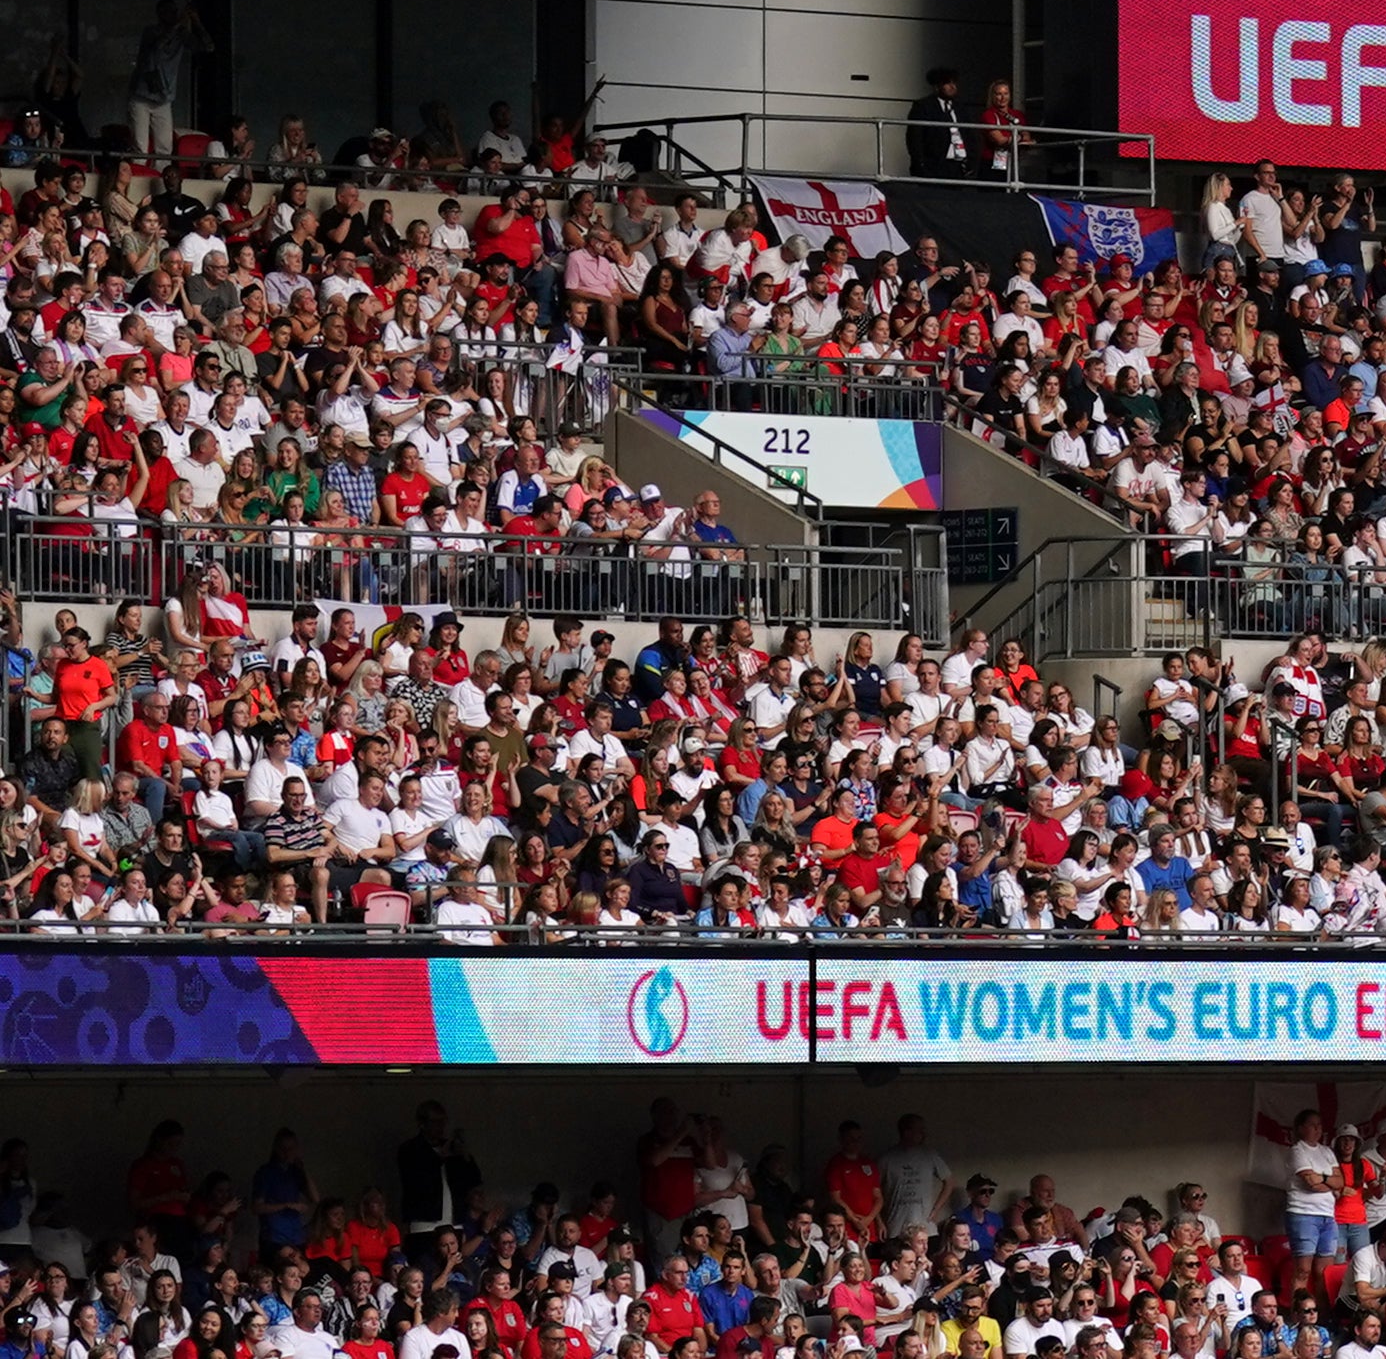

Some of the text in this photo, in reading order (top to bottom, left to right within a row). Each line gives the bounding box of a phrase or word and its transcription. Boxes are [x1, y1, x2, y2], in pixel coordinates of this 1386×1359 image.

[795, 207, 878, 227] ENGLAND
[763, 427, 810, 454] 212
[756, 980, 908, 1042] UEFA
[917, 980, 1177, 1043] WOMEN'S
[1192, 980, 1339, 1043] EURO
